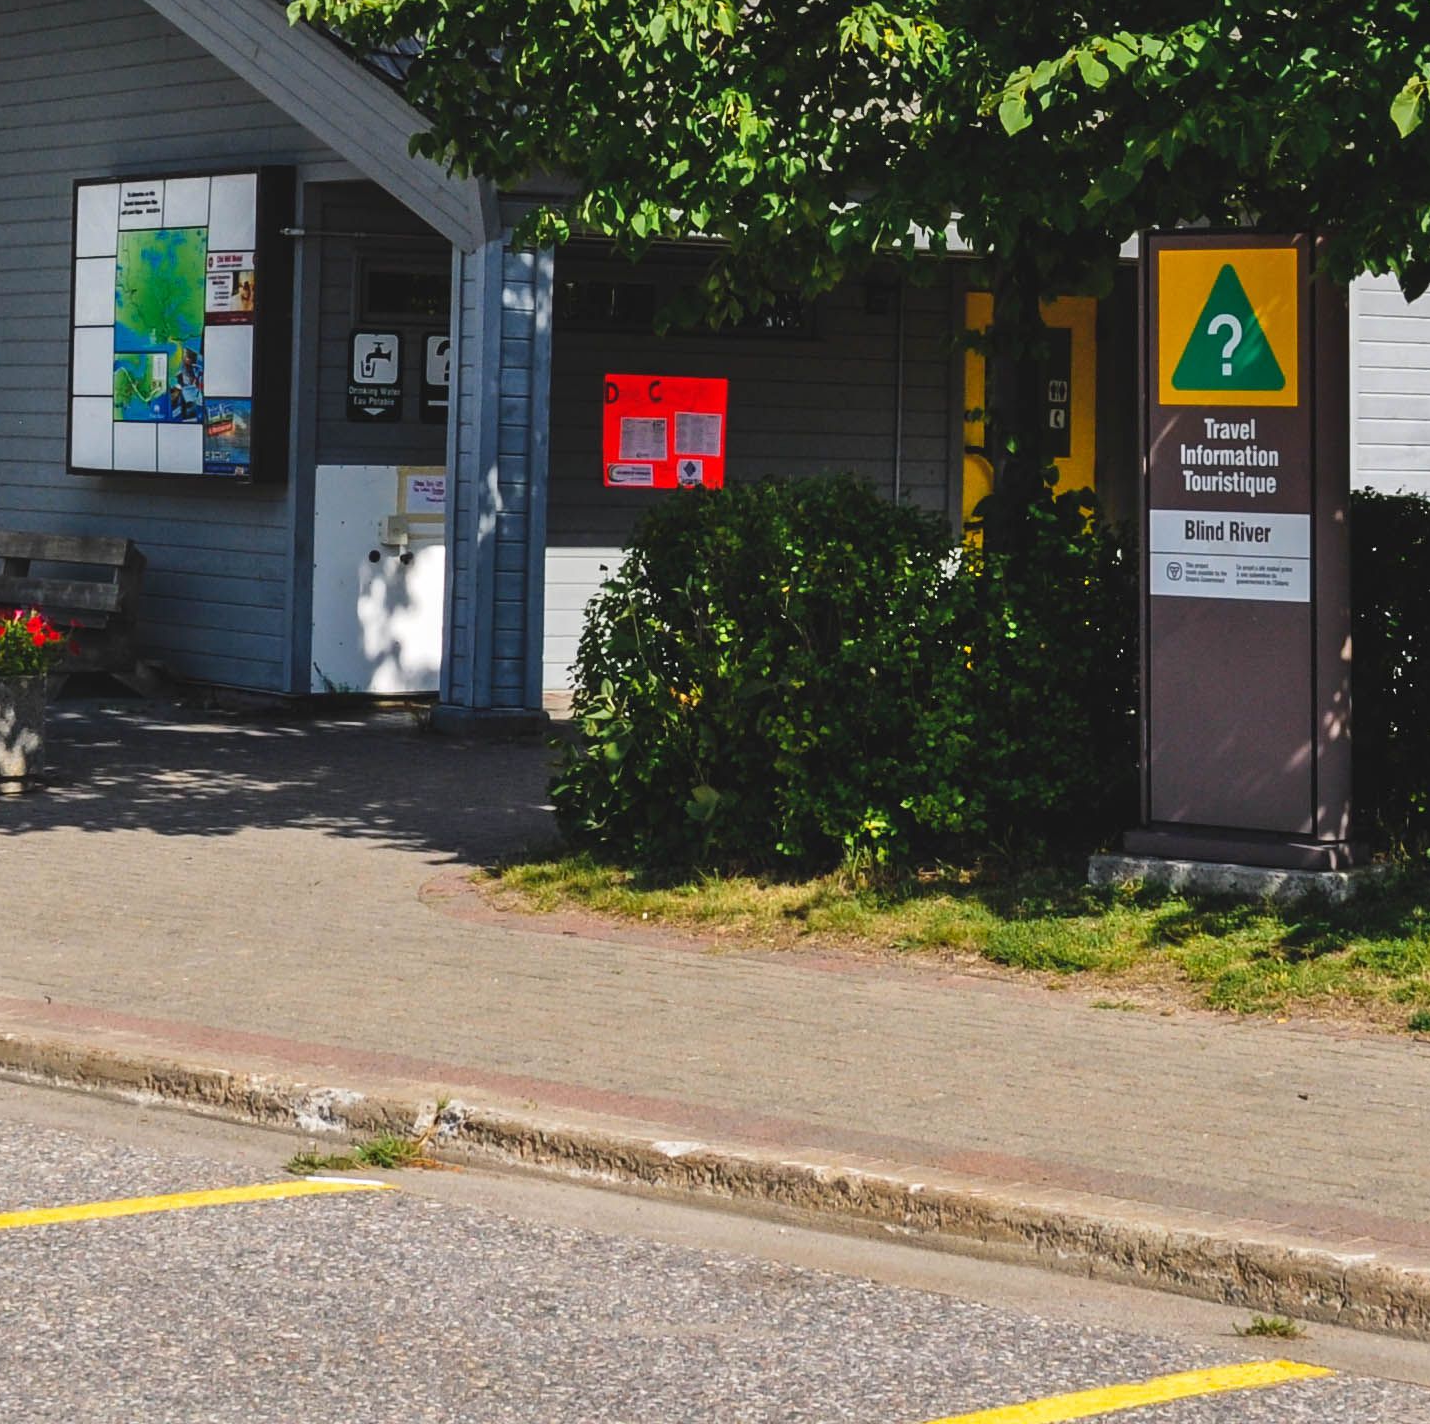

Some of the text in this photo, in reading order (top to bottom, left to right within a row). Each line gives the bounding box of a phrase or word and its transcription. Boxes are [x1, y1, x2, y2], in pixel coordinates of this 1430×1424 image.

[348, 386, 401, 397] Drinking Water
[1204, 418, 1256, 440] Travel
[1180, 444, 1279, 466] Information
[1182, 470, 1277, 497] Touristique
[1184, 520, 1271, 543] Blind River
